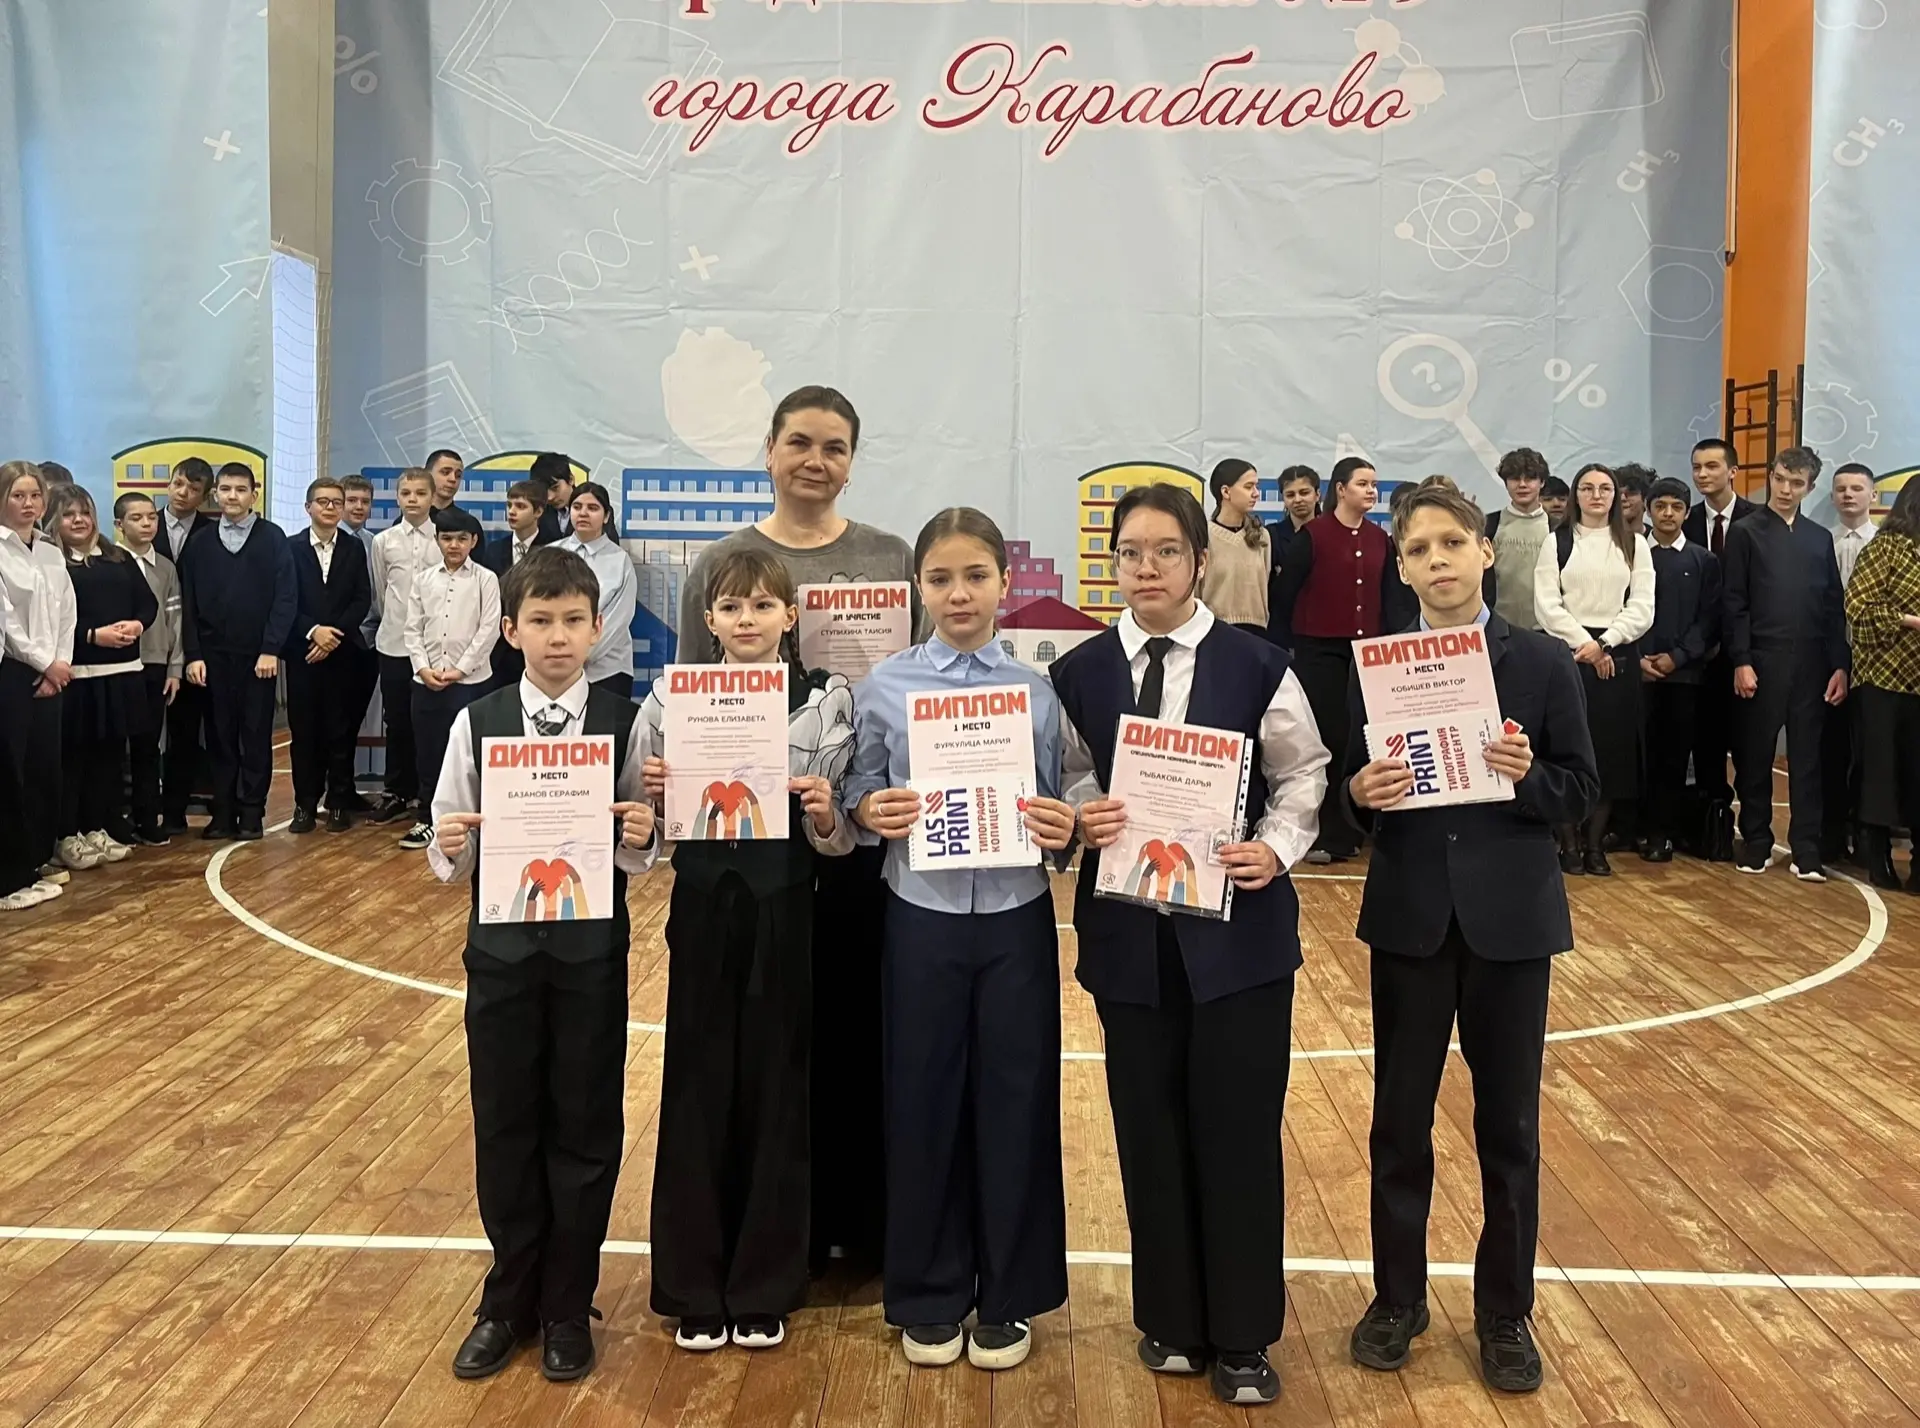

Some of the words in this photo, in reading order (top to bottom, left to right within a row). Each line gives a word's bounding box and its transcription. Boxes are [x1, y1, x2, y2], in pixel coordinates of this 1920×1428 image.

[648, 72, 896, 154] города
[922, 43, 1417, 157] Карабаново
[806, 587, 907, 610] ДИПЛОМ
[846, 613, 881, 621] УЧАСТИЕ
[864, 627, 892, 635] ТАИСИЯ
[1361, 630, 1483, 668] ДИПЛОМ
[1405, 667, 1411, 675] 1
[1414, 663, 1445, 674] МЕСТО
[670, 670, 784, 694] ДИПЛОМ
[1391, 682, 1431, 693] КОБИШЕВ
[1433, 677, 1466, 688] ВИКТОР
[710, 698, 716, 706] 2
[719, 698, 745, 706] МЕСТО
[913, 691, 1027, 721] ДИПЛОМ
[687, 715, 719, 723] РУНОВА
[721, 715, 766, 723] ЕЛИЗАВЕТА
[953, 724, 958, 732] 1
[962, 721, 991, 731] МЕСТО
[933, 739, 981, 750] ФУРКУЛИЦА
[983, 737, 1011, 746] МАРИЯ
[1123, 722, 1239, 762] ДИПЛОМ
[488, 743, 610, 769] ДИПЛОМ
[1437, 726, 1459, 792] ТИПОГРАФИЯ
[1449, 725, 1471, 790] КОПИЦЕНТР
[531, 772, 537, 780] 3
[540, 772, 569, 780] МЕСТО
[1139, 770, 1183, 783] РЫБАКОВА
[1185, 777, 1212, 788] ДАРЬЯ
[508, 789, 547, 798] БАЗАНОВ
[549, 789, 590, 798] СЕРАФИМ
[975, 786, 988, 854] ТИПОГРАФИЯ
[987, 786, 1001, 853] КОПИЦЕНТР
[925, 817, 946, 858] LAS
